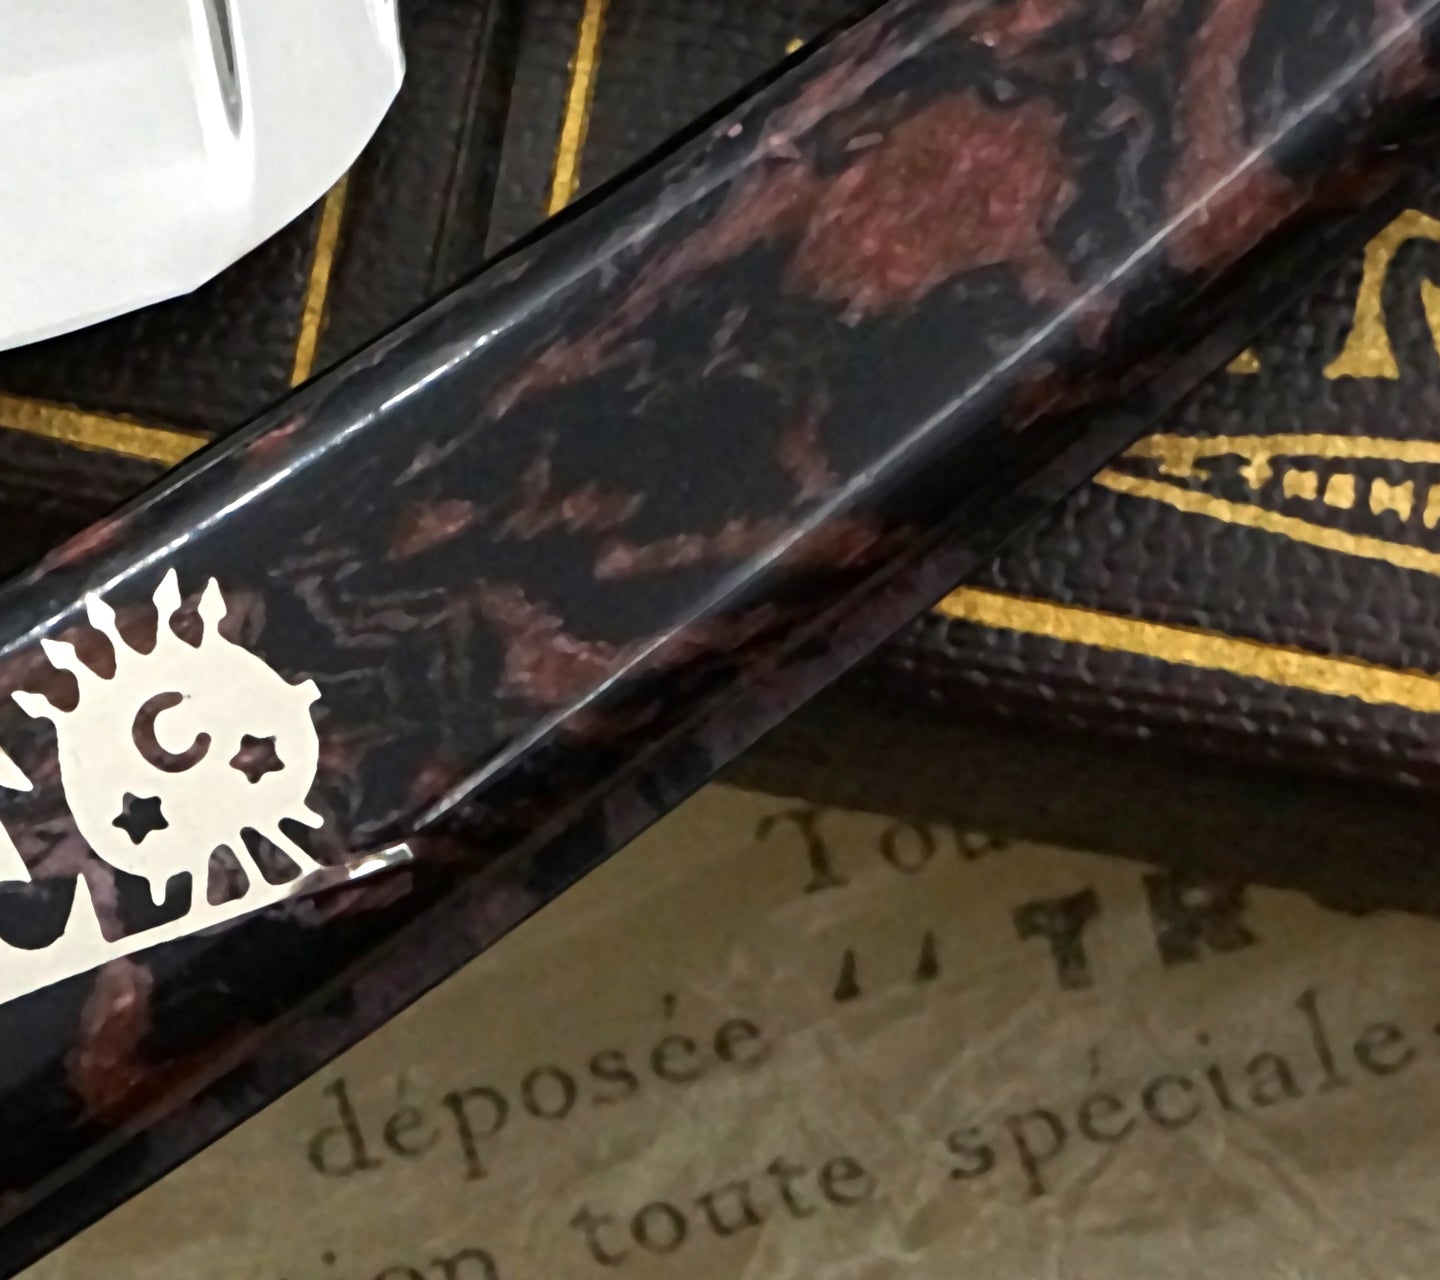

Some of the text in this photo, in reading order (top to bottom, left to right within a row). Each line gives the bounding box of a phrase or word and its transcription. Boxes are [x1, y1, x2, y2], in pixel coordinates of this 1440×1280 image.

[132, 690, 212, 773] C
[305, 992, 776, 1184] déposée
[568, 1150, 877, 1269] toute
